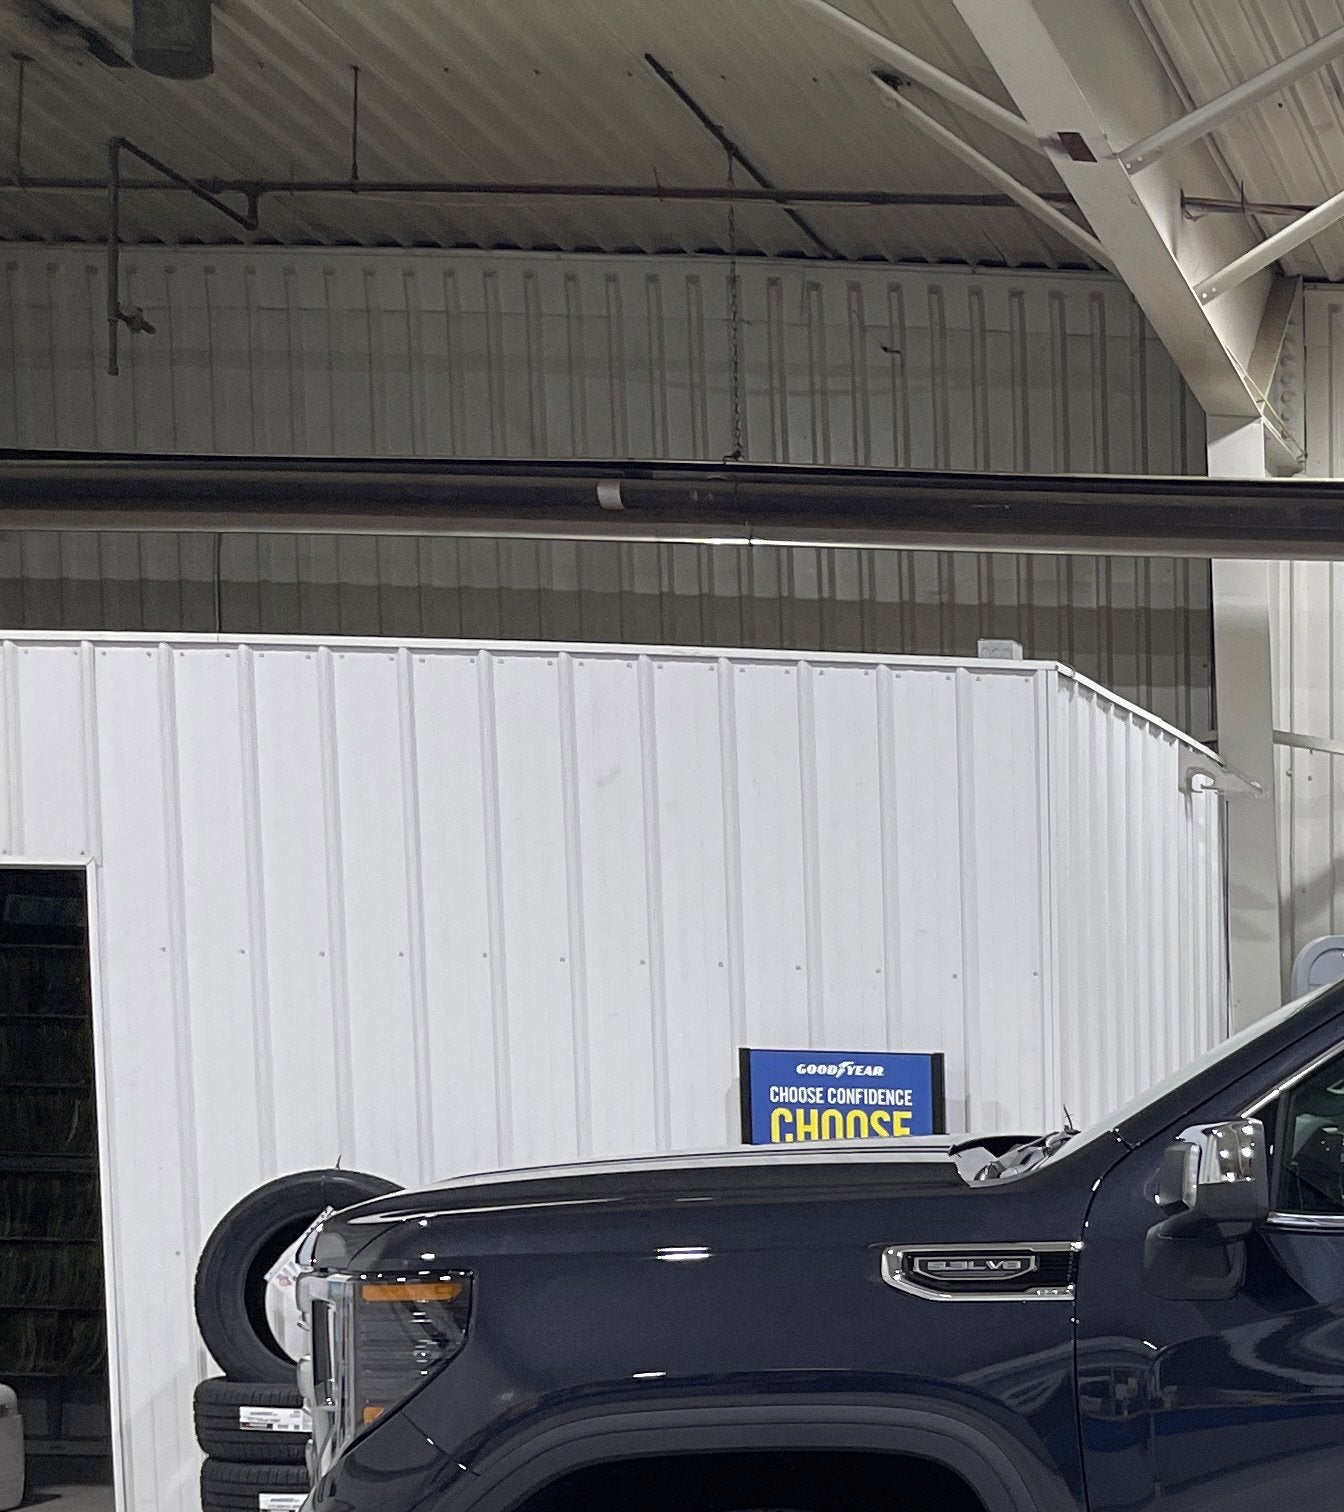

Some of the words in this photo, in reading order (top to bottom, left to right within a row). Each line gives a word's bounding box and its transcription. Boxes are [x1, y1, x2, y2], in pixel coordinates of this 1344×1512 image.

[796, 1061, 884, 1078] GOODYEAR
[770, 1086, 824, 1104] CHOOSE
[828, 1088, 912, 1106] CONFIDENCE
[771, 1107, 913, 1144] CHOOSE
